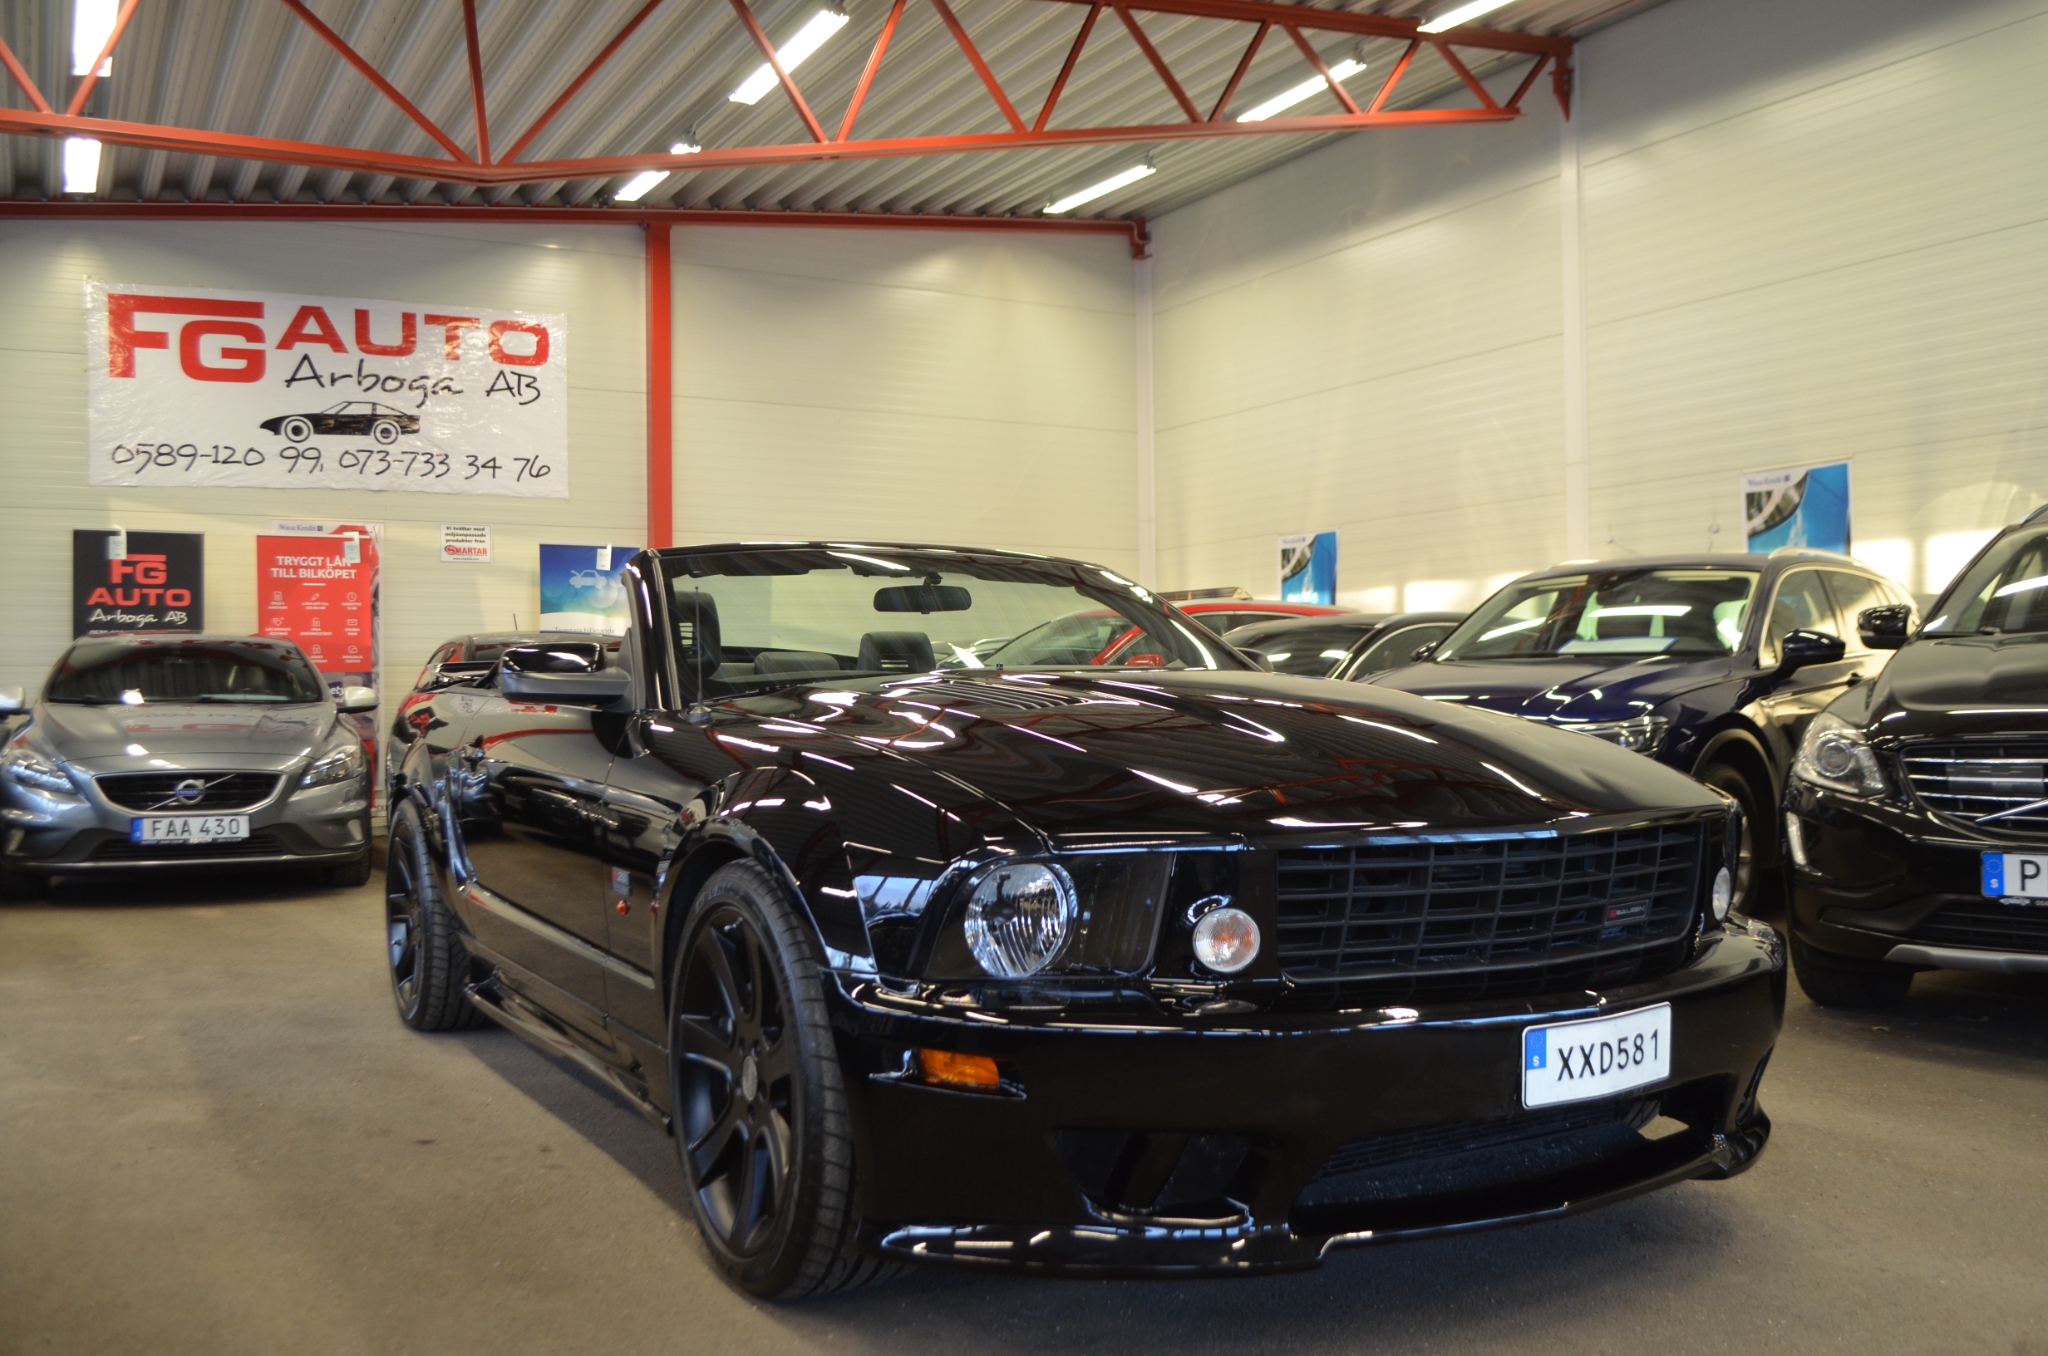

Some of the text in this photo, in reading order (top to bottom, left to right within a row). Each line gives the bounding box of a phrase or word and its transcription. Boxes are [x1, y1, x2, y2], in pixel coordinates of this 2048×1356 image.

[108, 292, 550, 384] FG AUTO
[284, 353, 542, 408] Arboga AB
[111, 443, 266, 475] 0589-120
[338, 448, 451, 479] 073-733
[463, 455, 503, 480] 34
[513, 455, 552, 481] 76
[110, 553, 167, 585] FG
[270, 566, 358, 579] TILL BILKÖPET
[276, 555, 324, 567] TRYGGT
[87, 587, 192, 607] AUTO
[90, 608, 188, 628] Arboga AB
[152, 819, 192, 837] FAA
[200, 818, 240, 835] 430
[1532, 1028, 1659, 1081] S XXD581
